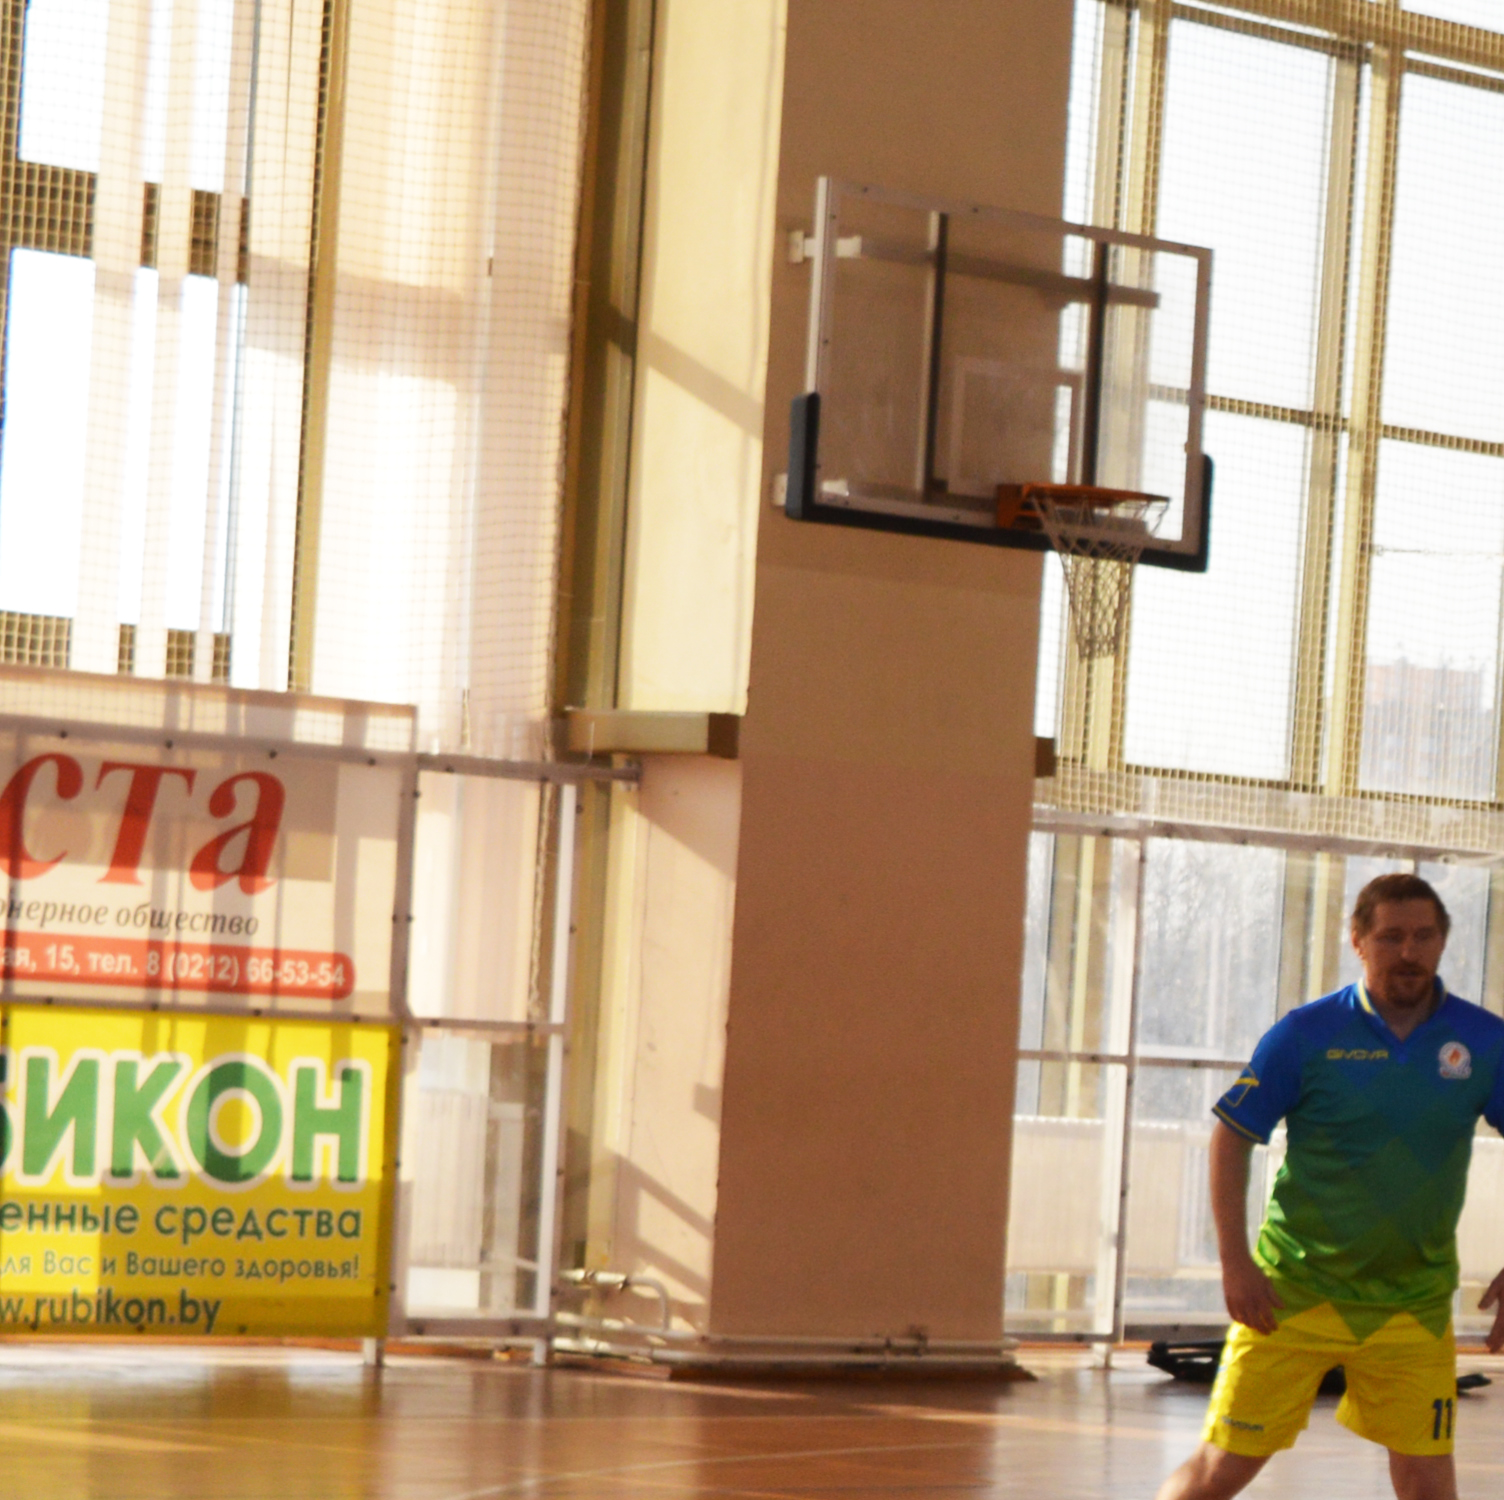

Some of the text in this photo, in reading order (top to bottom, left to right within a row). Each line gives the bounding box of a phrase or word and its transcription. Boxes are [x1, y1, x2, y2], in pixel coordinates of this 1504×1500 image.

[0, 752, 286, 895] ста
[116, 901, 259, 936] общество
[46, 943, 80, 975] 15,
[88, 951, 138, 975] тел.
[147, 950, 161, 976] 8
[167, 950, 239, 985] (0212)
[247, 955, 345, 987] 66-53-54
[0, 1054, 363, 1184] ИКОН
[154, 1204, 362, 1246] средства
[0, 1250, 360, 1285] ля Вас и Вашего здоровья!
[1432, 1397, 1453, 1441] 11
